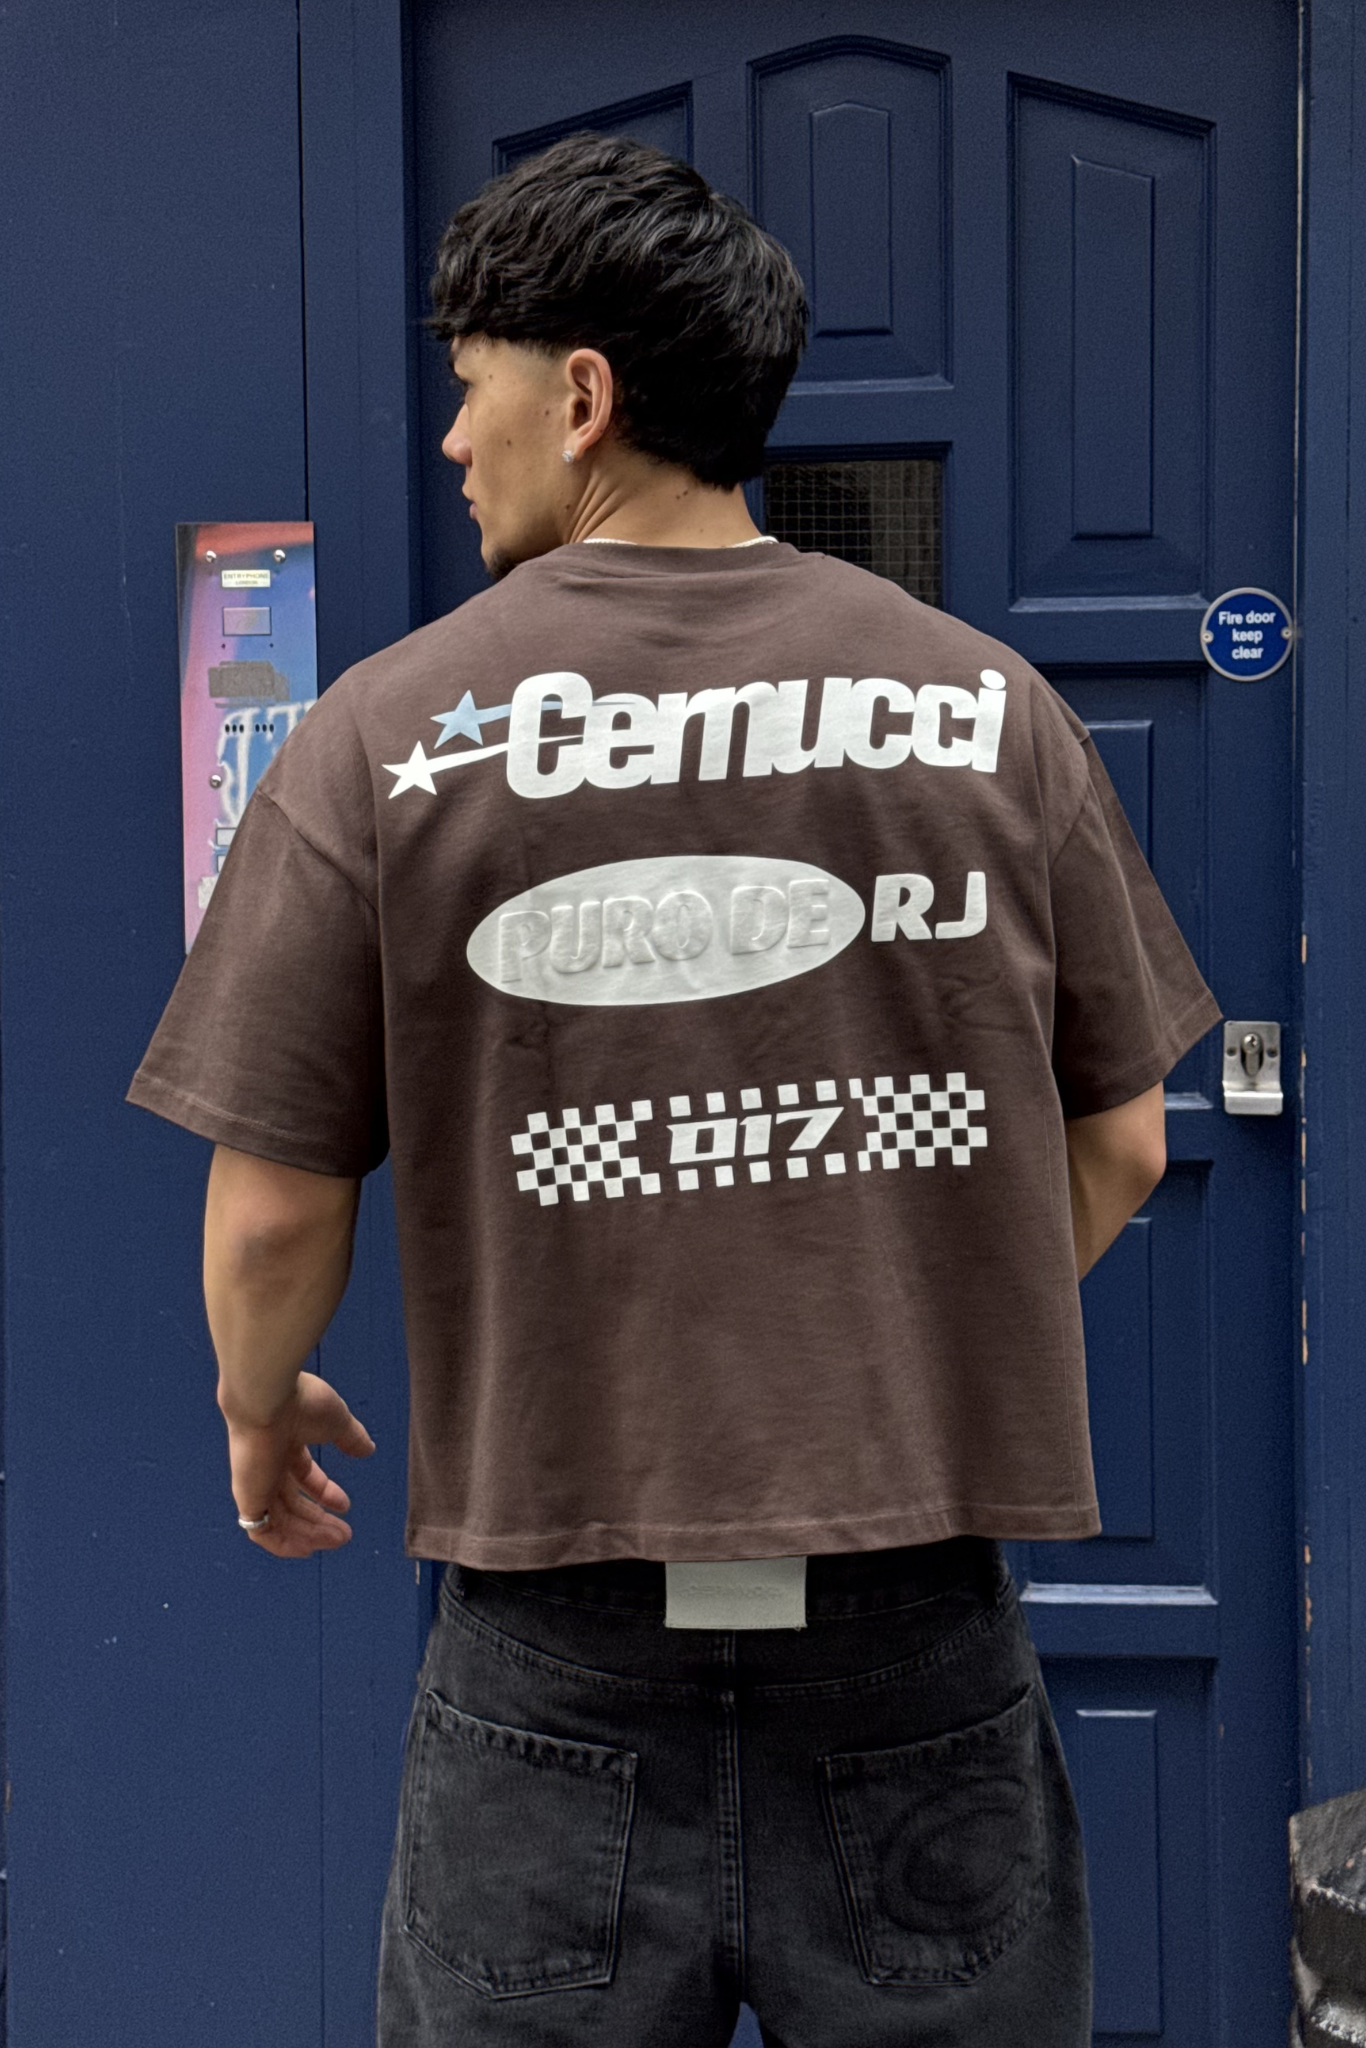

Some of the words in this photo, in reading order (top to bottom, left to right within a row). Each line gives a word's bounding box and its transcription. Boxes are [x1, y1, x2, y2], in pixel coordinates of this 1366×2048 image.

[1218, 611, 1243, 625] Fire
[1245, 610, 1276, 624] door
[1232, 628, 1263, 644] keep
[1231, 645, 1264, 660] clear
[499, 890, 714, 983] PURO
[729, 878, 830, 955] DE
[871, 871, 988, 942] RJ
[666, 1106, 845, 1164] 017
